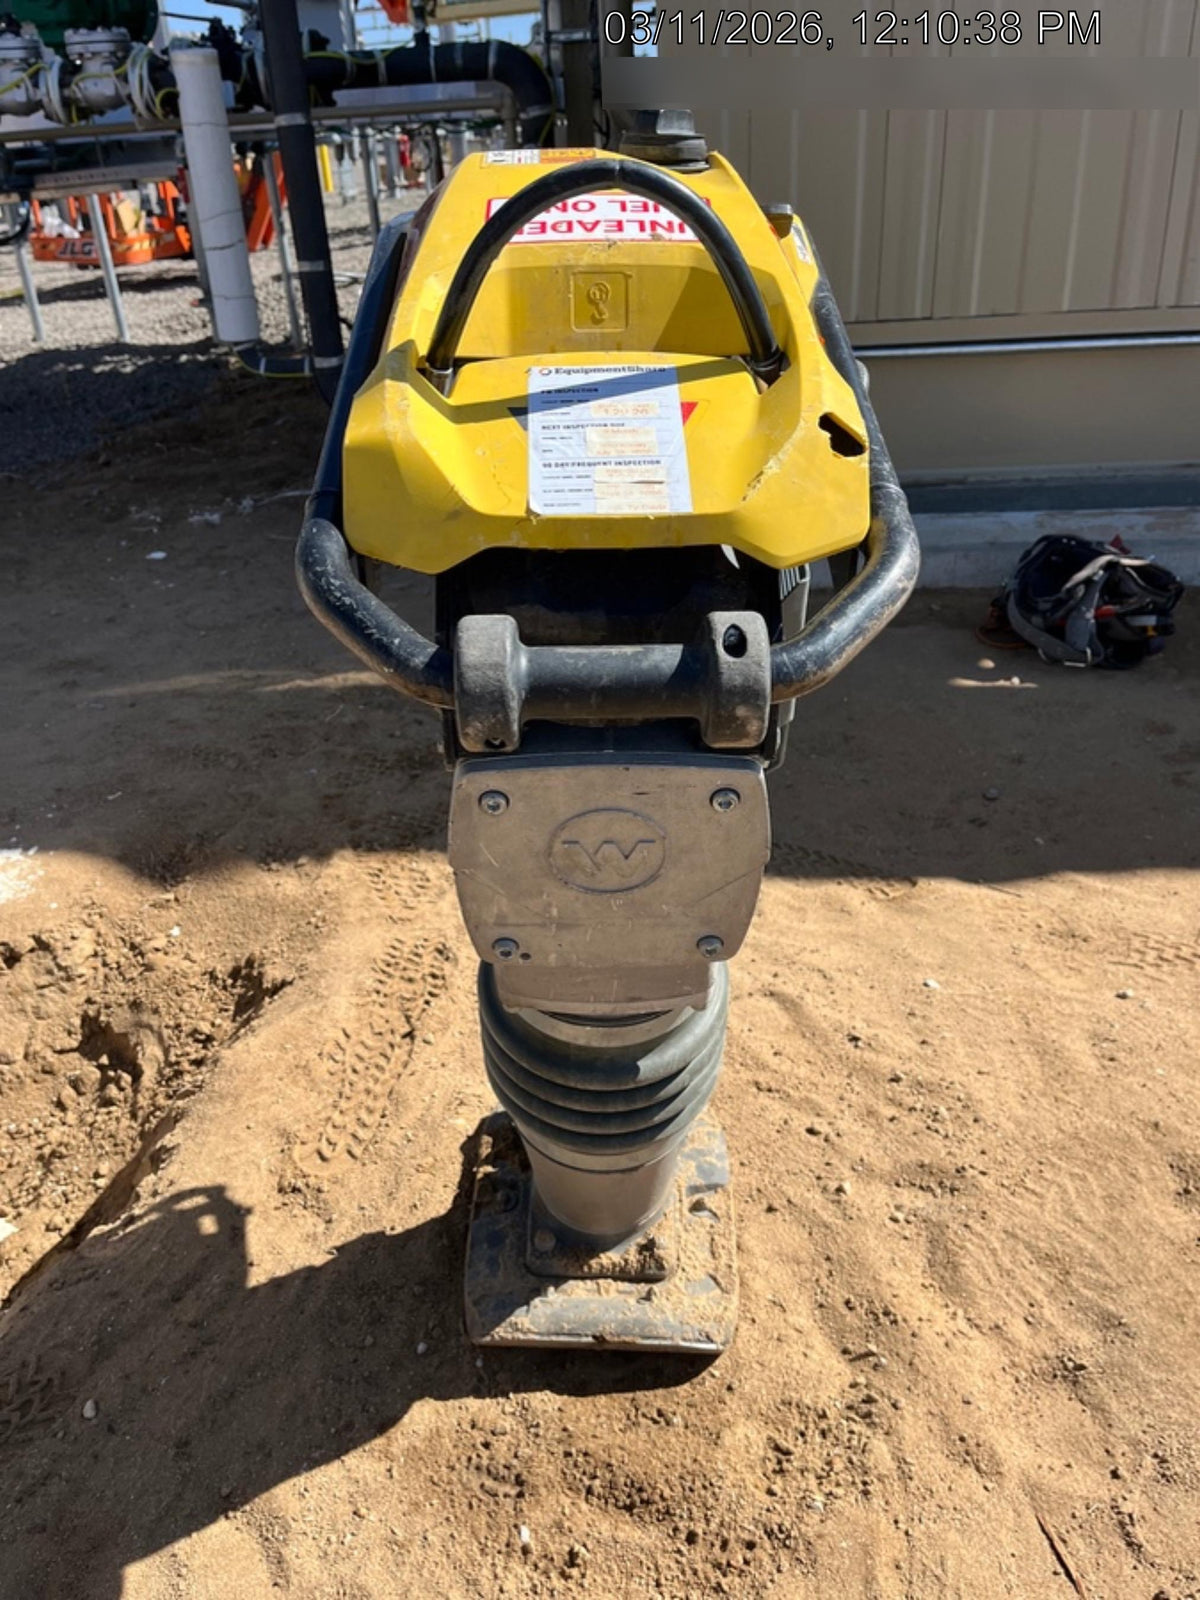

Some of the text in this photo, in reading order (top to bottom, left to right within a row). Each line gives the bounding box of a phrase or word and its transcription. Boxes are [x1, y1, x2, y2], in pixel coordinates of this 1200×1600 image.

[515, 219, 686, 234] NLEADE
[58, 241, 94, 256] JLG
[614, 458, 662, 467] INSPECTION
